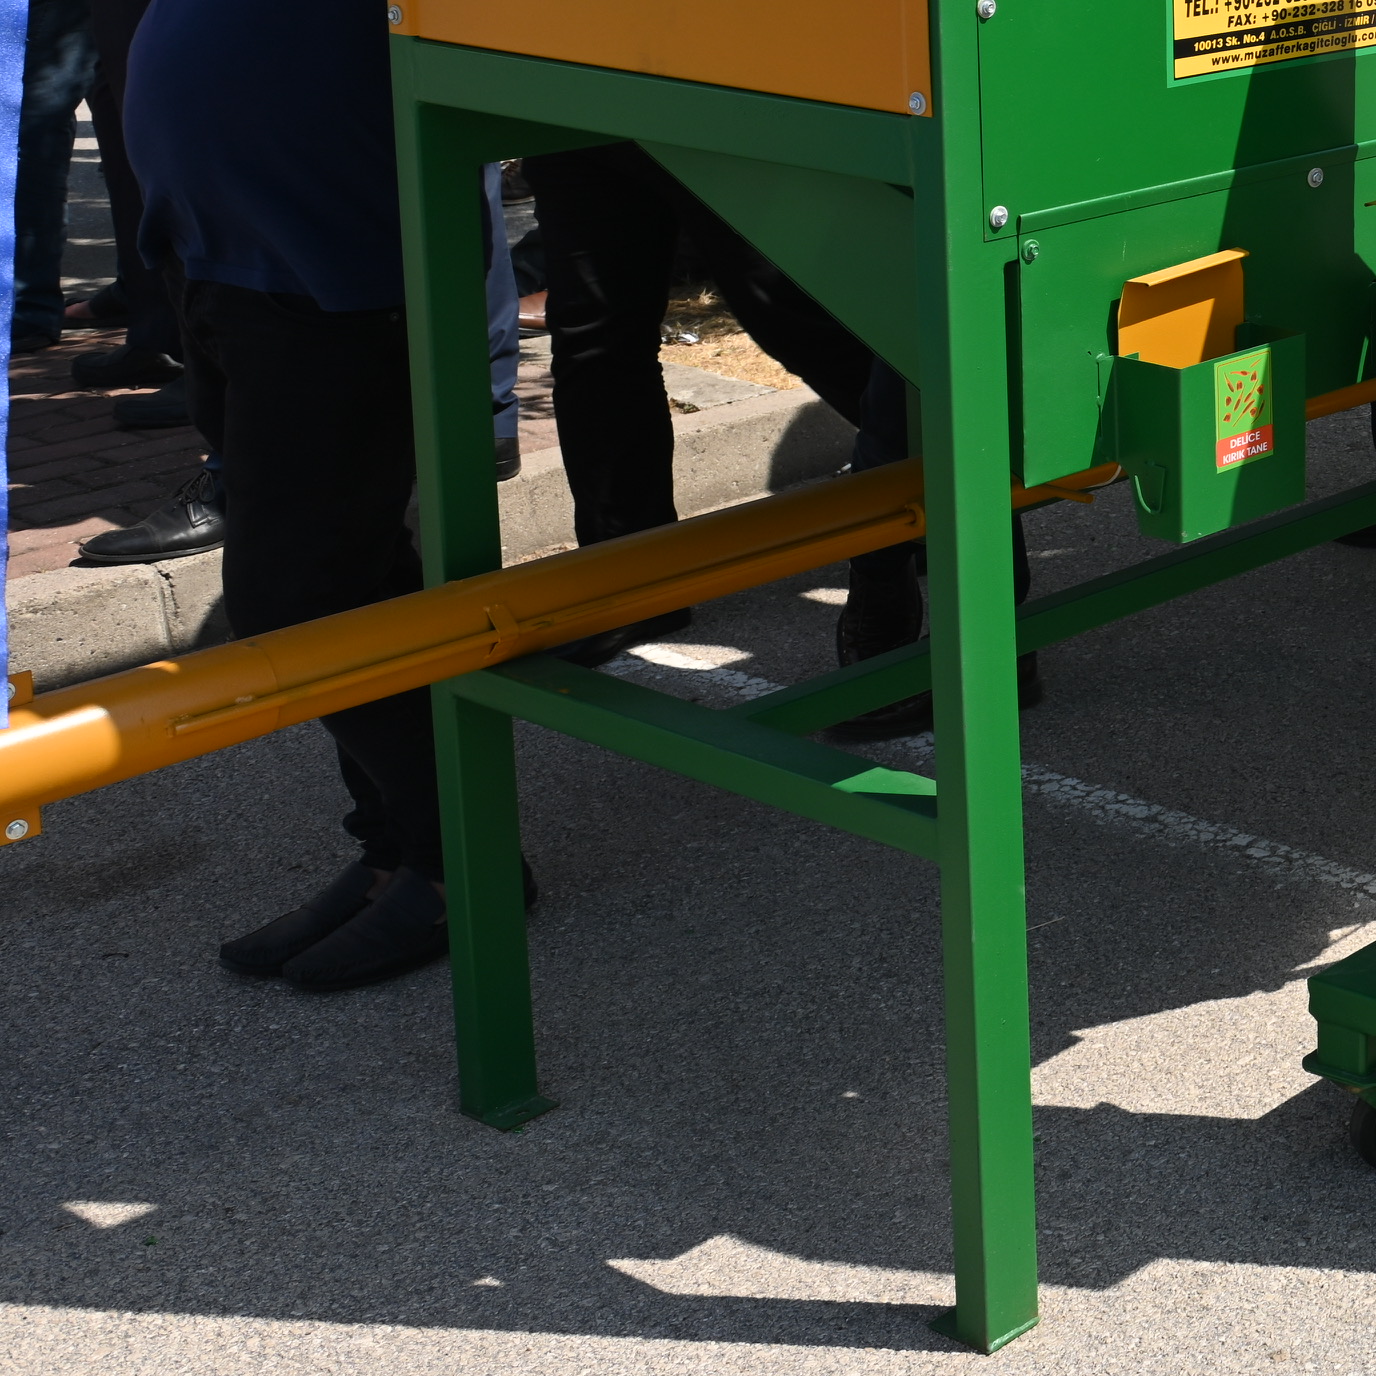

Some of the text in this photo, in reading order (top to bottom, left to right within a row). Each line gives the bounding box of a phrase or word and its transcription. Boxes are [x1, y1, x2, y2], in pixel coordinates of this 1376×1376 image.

[1227, 14, 1257, 29] FAX:
[1194, 36, 1224, 53] 10013
[1225, 35, 1241, 47] Sk.
[1243, 31, 1265, 45] No.4
[1270, 25, 1307, 40] A.O.S.B.
[1312, 17, 1337, 33] ÇİĞLİ
[1344, 13, 1370, 28] İZMİR
[1230, 431, 1260, 449] DELİCE
[1222, 442, 1268, 464] KIRIK TANE
